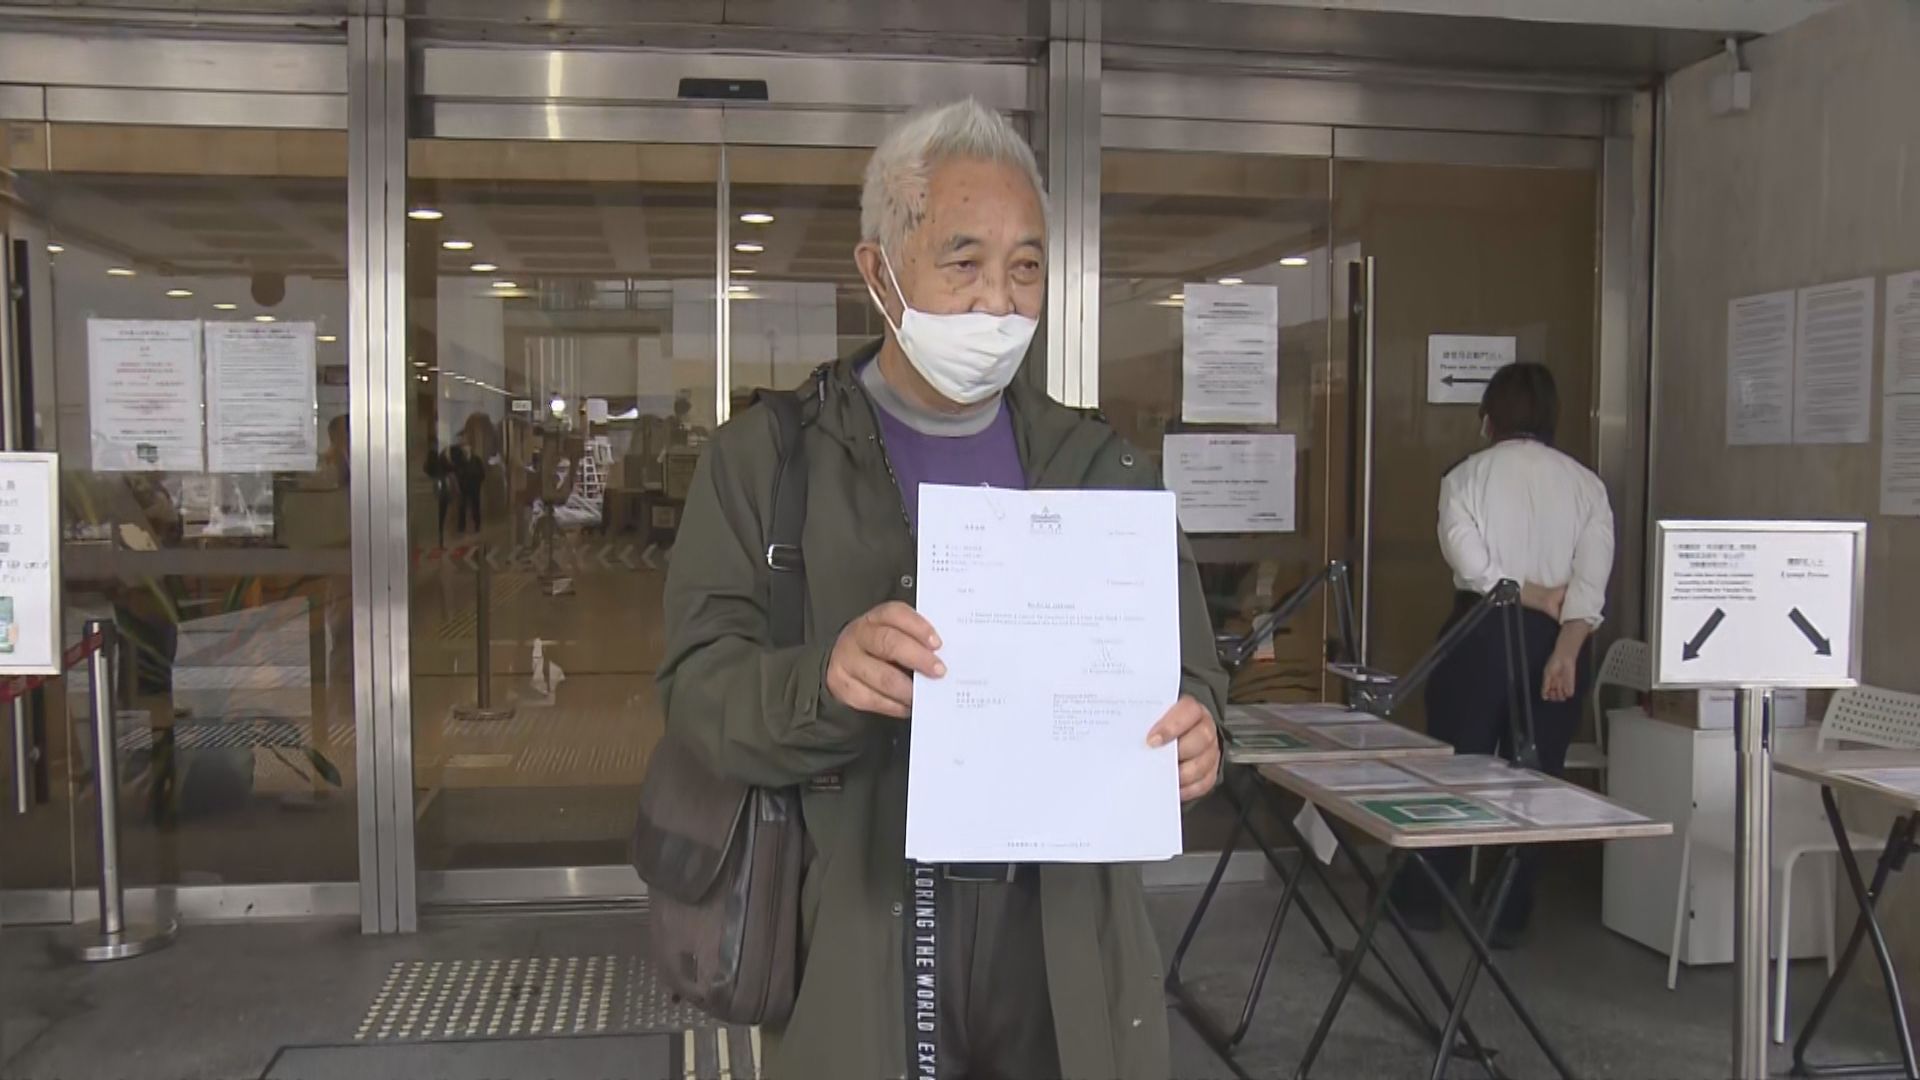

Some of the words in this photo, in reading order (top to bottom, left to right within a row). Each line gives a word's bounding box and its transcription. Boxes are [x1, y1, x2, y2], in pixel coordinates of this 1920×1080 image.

[915, 868, 935, 928] LORING
[916, 934, 935, 968] THE
[916, 974, 936, 1032] WORLD
